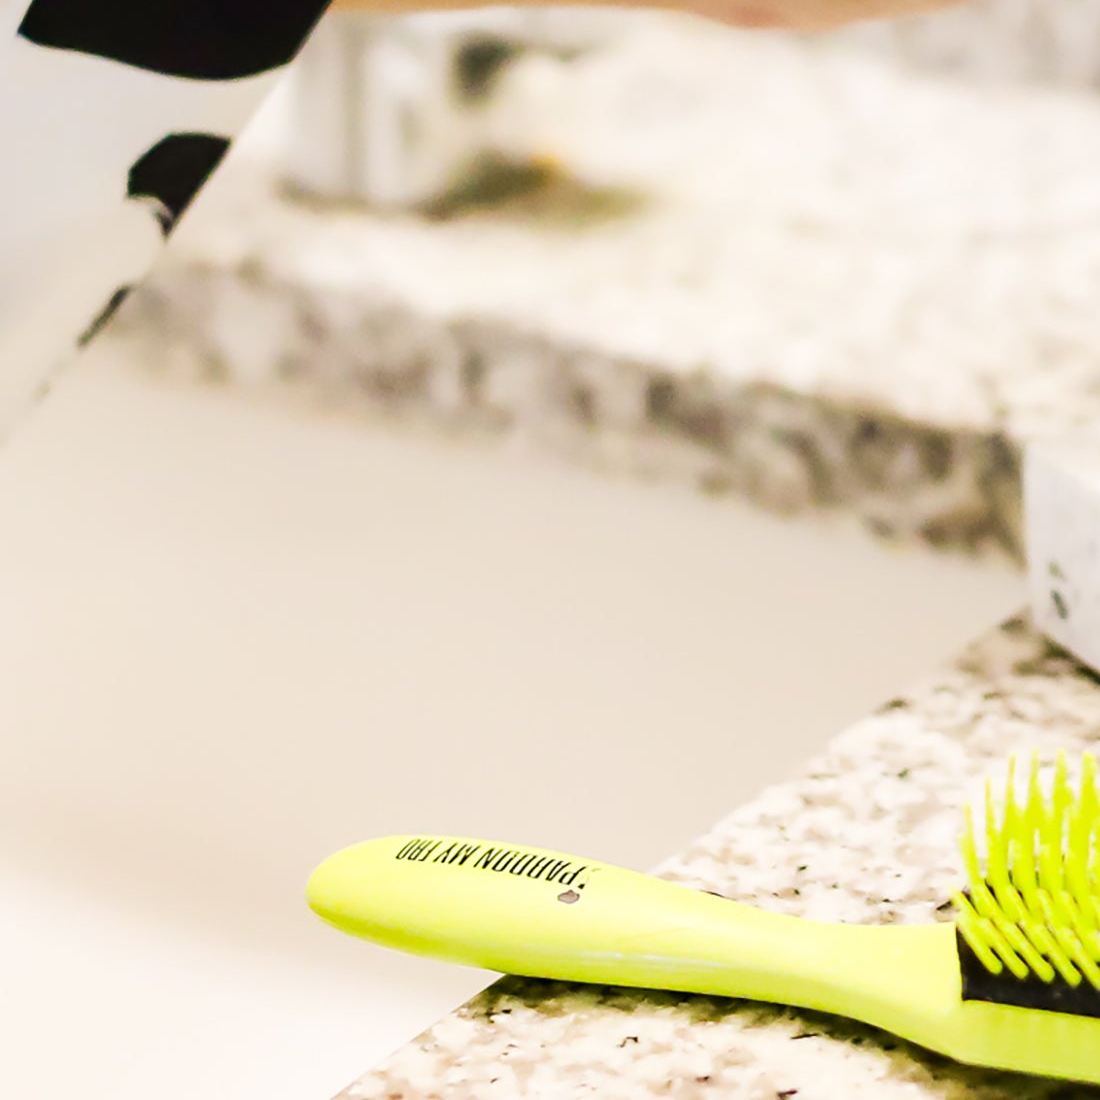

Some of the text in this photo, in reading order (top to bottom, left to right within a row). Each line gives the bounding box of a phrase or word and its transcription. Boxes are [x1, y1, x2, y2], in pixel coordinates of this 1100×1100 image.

[395, 838, 588, 886] PARDON MY FRO
